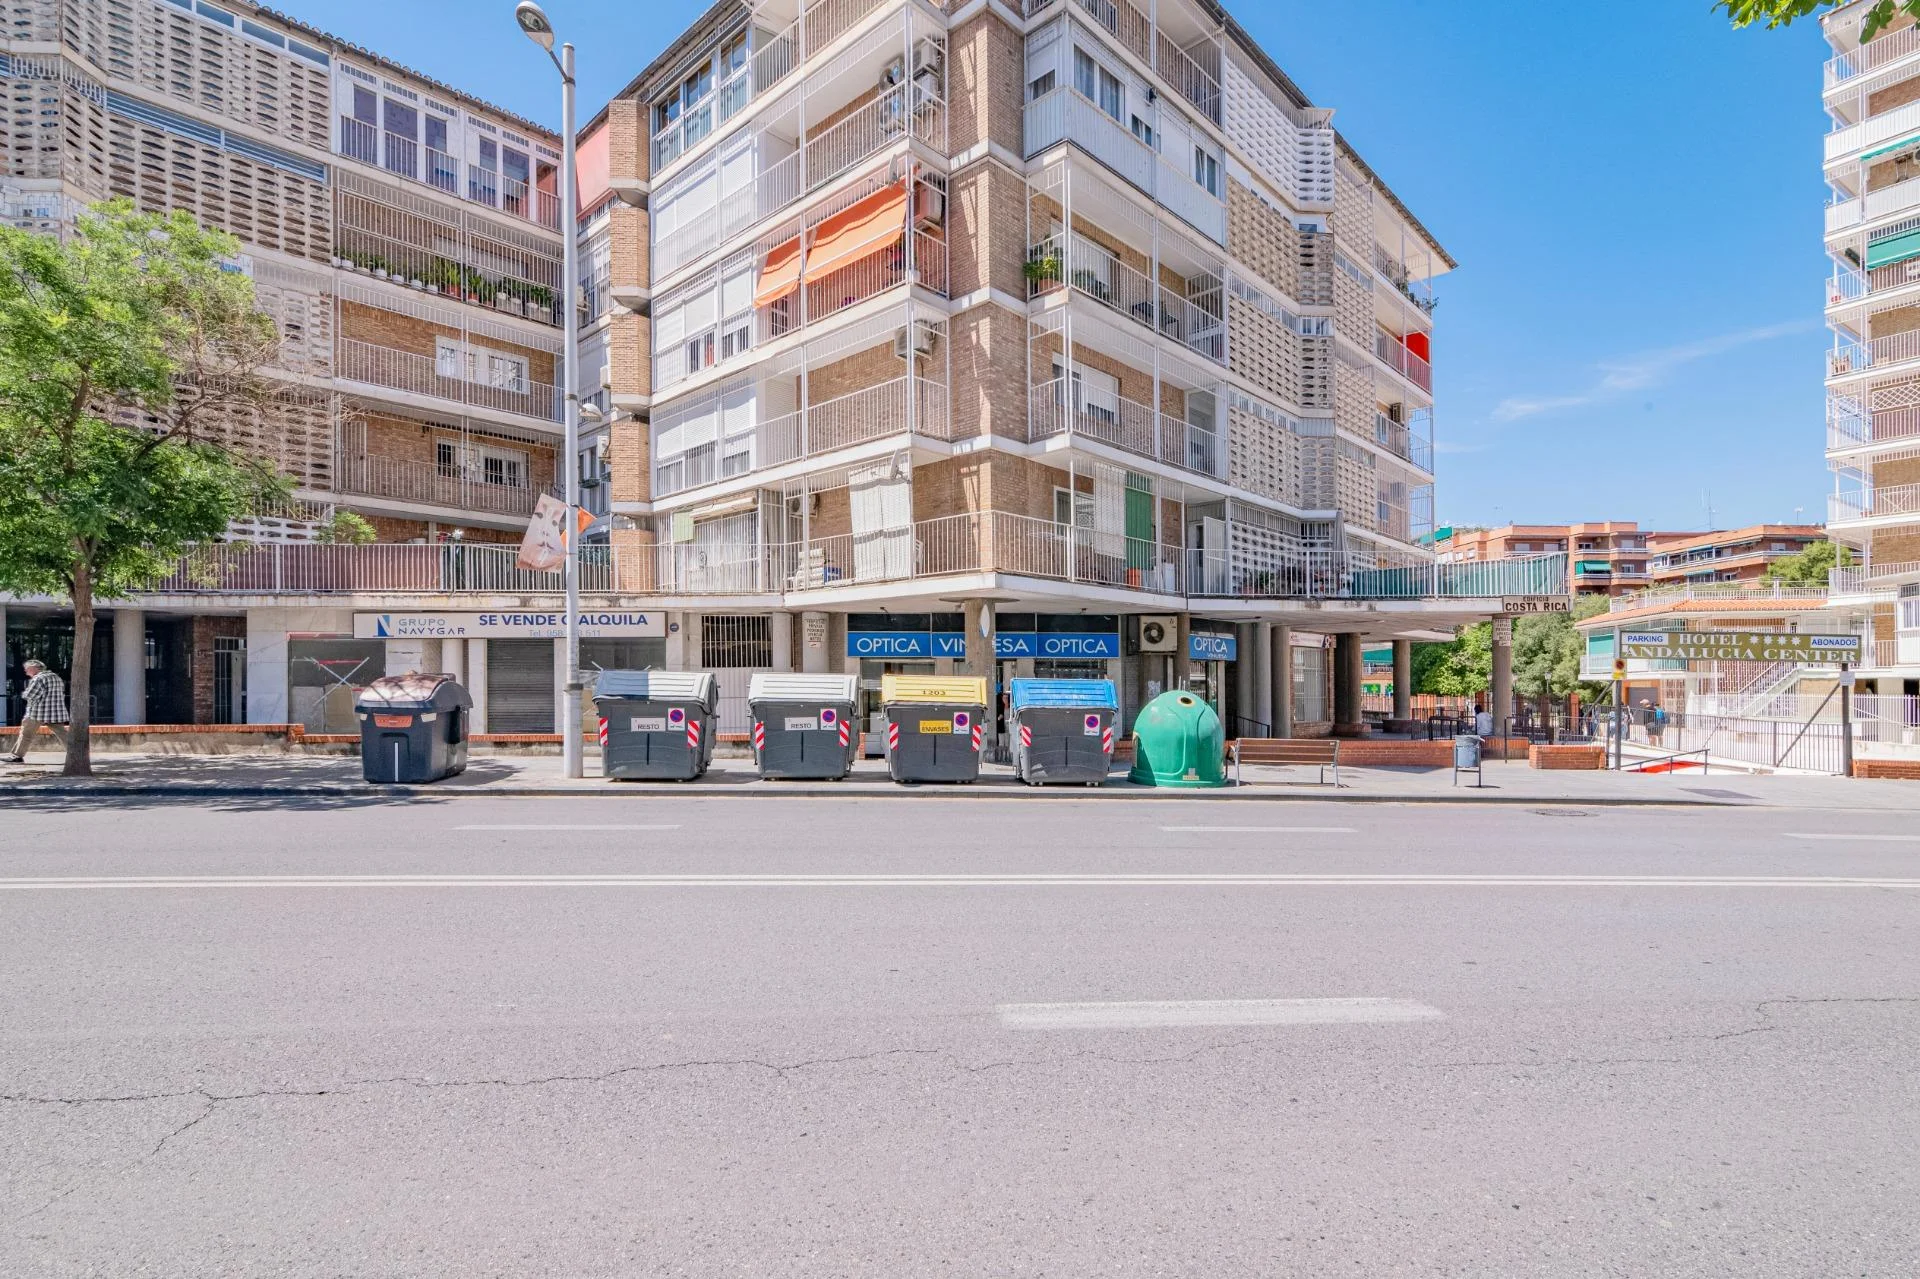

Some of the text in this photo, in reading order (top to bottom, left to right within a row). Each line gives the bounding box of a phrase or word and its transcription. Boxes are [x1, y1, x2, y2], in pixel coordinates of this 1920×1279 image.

[1505, 602, 1567, 611] COSTA RICA
[398, 618, 446, 627] GRUPO
[479, 614, 498, 626] SE
[502, 614, 556, 626] VENDE
[578, 614, 648, 626] ALQUILA
[398, 627, 466, 635] NAVYGAR
[1627, 635, 1664, 643] PARKING
[1679, 633, 1743, 646] HOTEL
[1811, 638, 1858, 647] ABONADOS
[856, 637, 921, 653] OPTICA
[1044, 638, 1109, 654] OPTICA
[1193, 636, 1228, 653] OPTICA
[1763, 648, 1857, 661] CENTER
